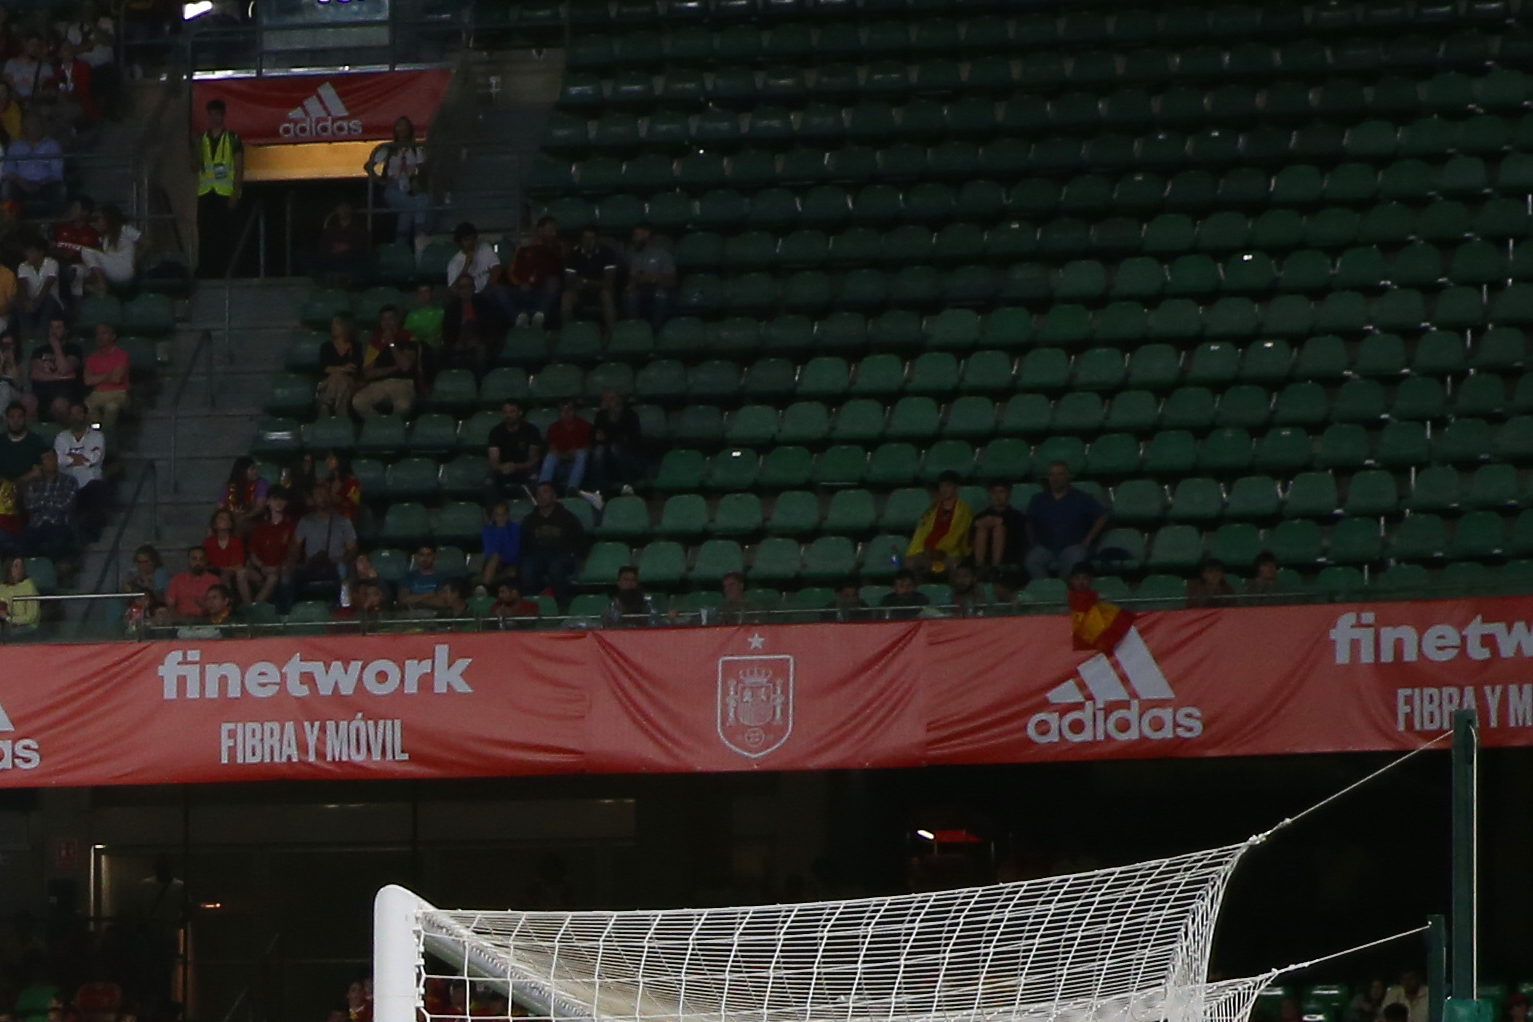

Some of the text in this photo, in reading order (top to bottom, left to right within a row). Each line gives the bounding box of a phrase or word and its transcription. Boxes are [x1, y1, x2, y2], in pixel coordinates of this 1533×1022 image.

[279, 117, 363, 138] adidas
[1329, 612, 1533, 665] finetw
[158, 644, 474, 699] finetwork
[1026, 700, 1203, 744] adidas
[1483, 685, 1502, 728] Y
[221, 712, 409, 764] FIBRA Y MÓVIL
